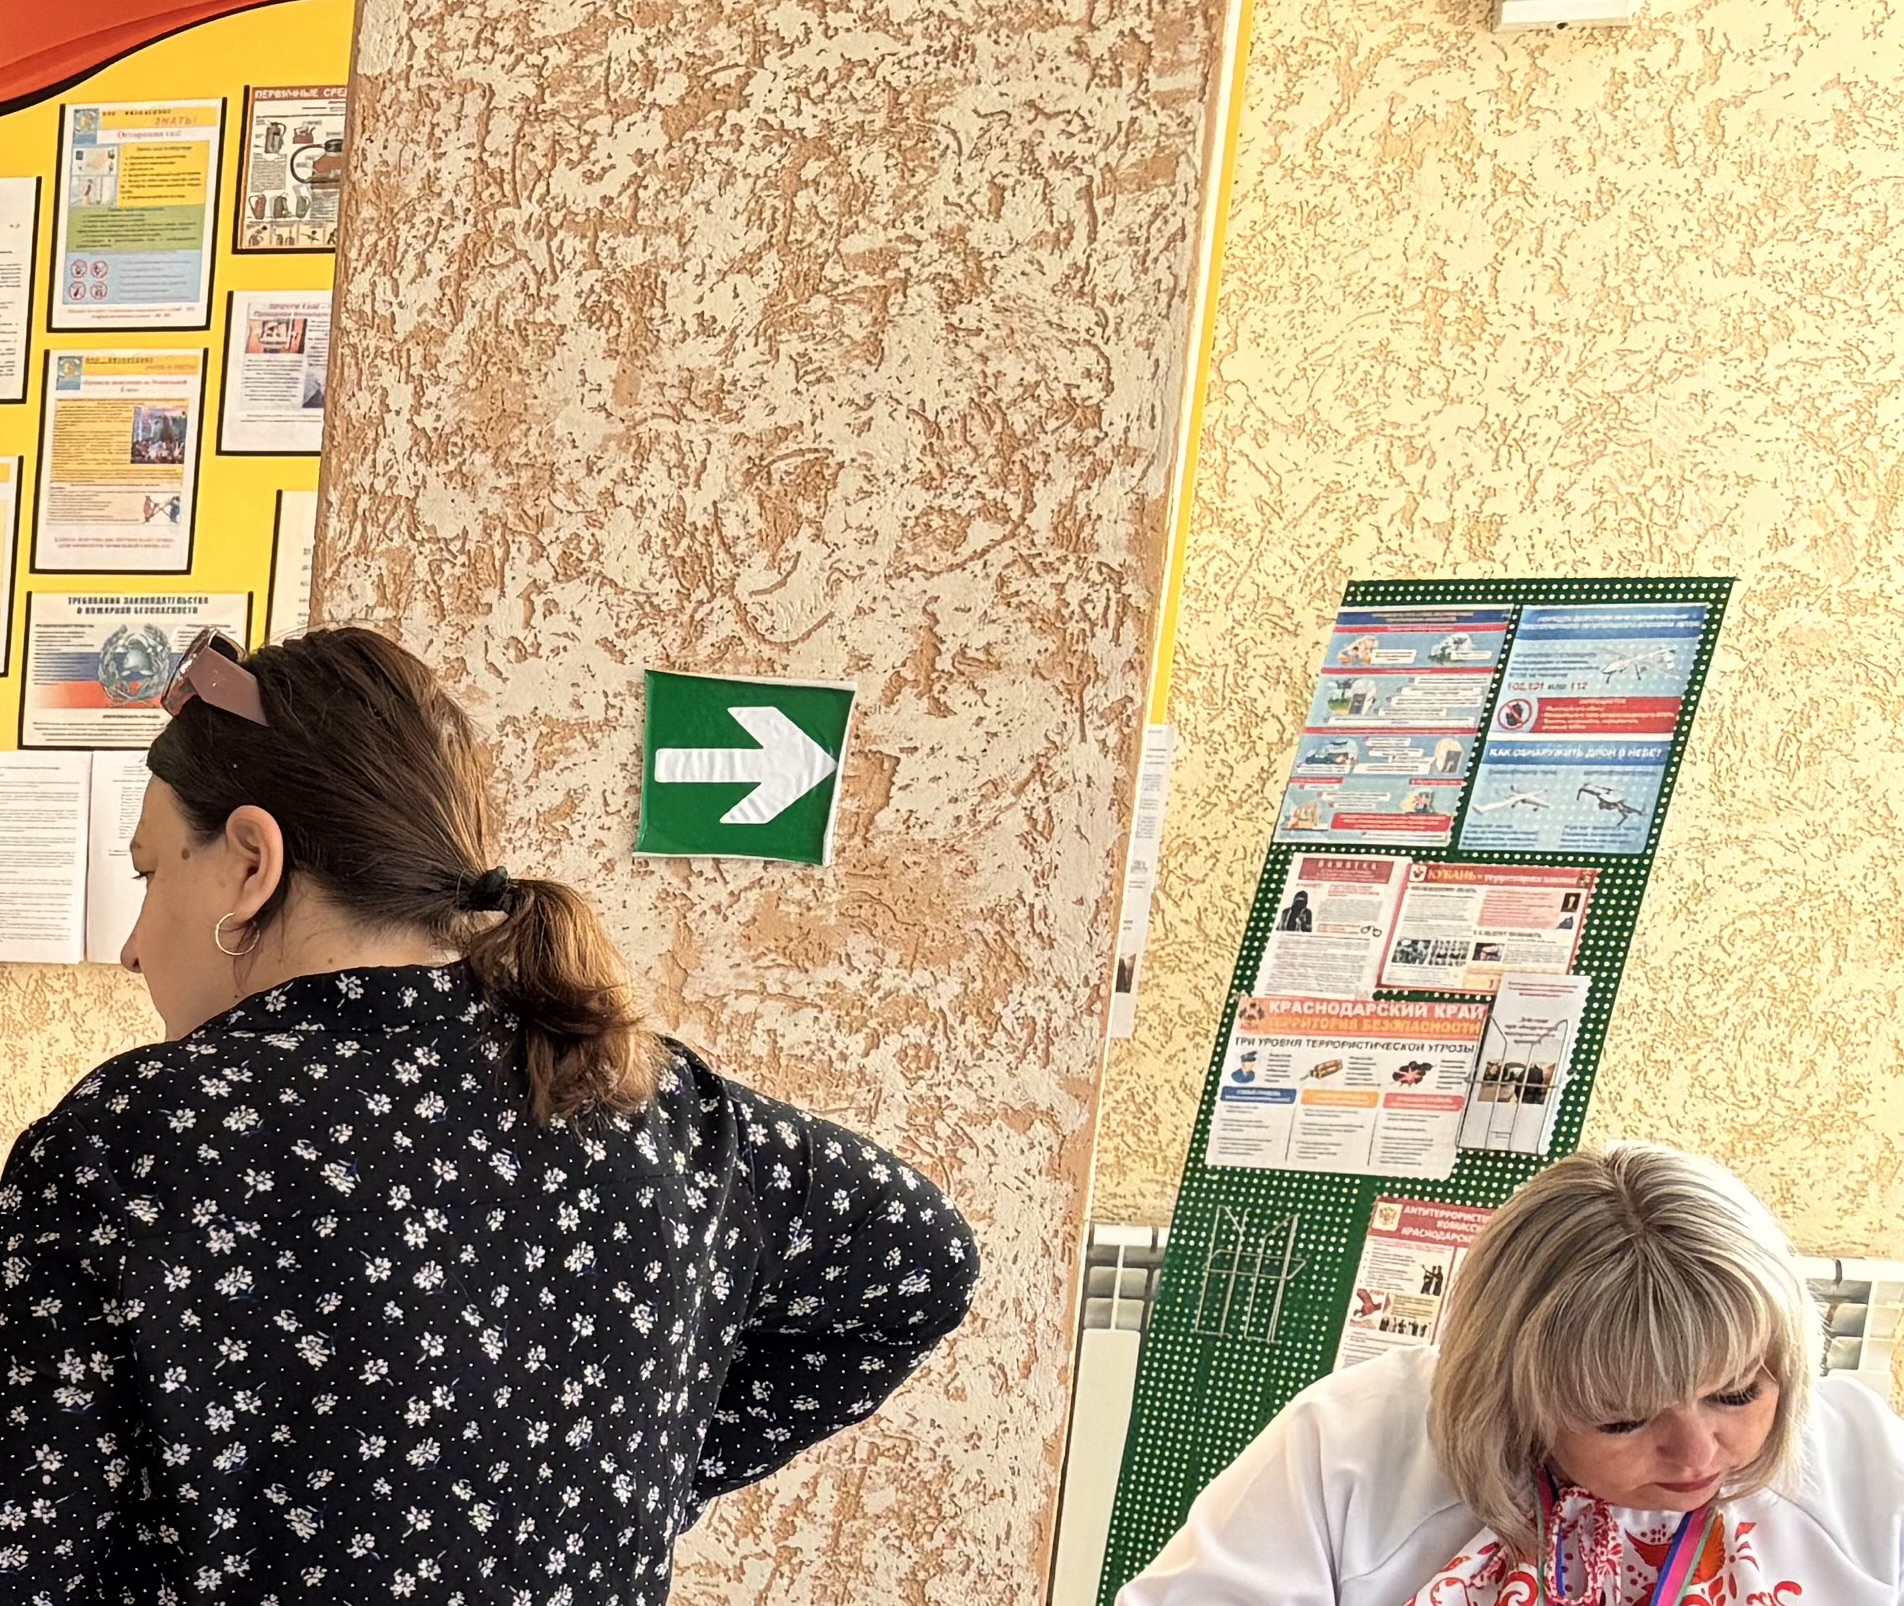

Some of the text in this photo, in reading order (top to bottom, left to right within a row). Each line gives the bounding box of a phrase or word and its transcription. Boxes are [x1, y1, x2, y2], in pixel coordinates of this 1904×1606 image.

[1490, 748, 1511, 757] КАК
[1427, 868, 1476, 881] КУБАНЬ
[1269, 1001, 1485, 1020] КРАСНОДАРСКИЙ КРАЙ
[1362, 1019, 1481, 1034] БЕЗОПАСНОСТИ
[1236, 1037, 1476, 1053] ТРИ УРОВНЯ ТЕРРОРИСТИЧЕСКОЙ УГРОЗЫ
